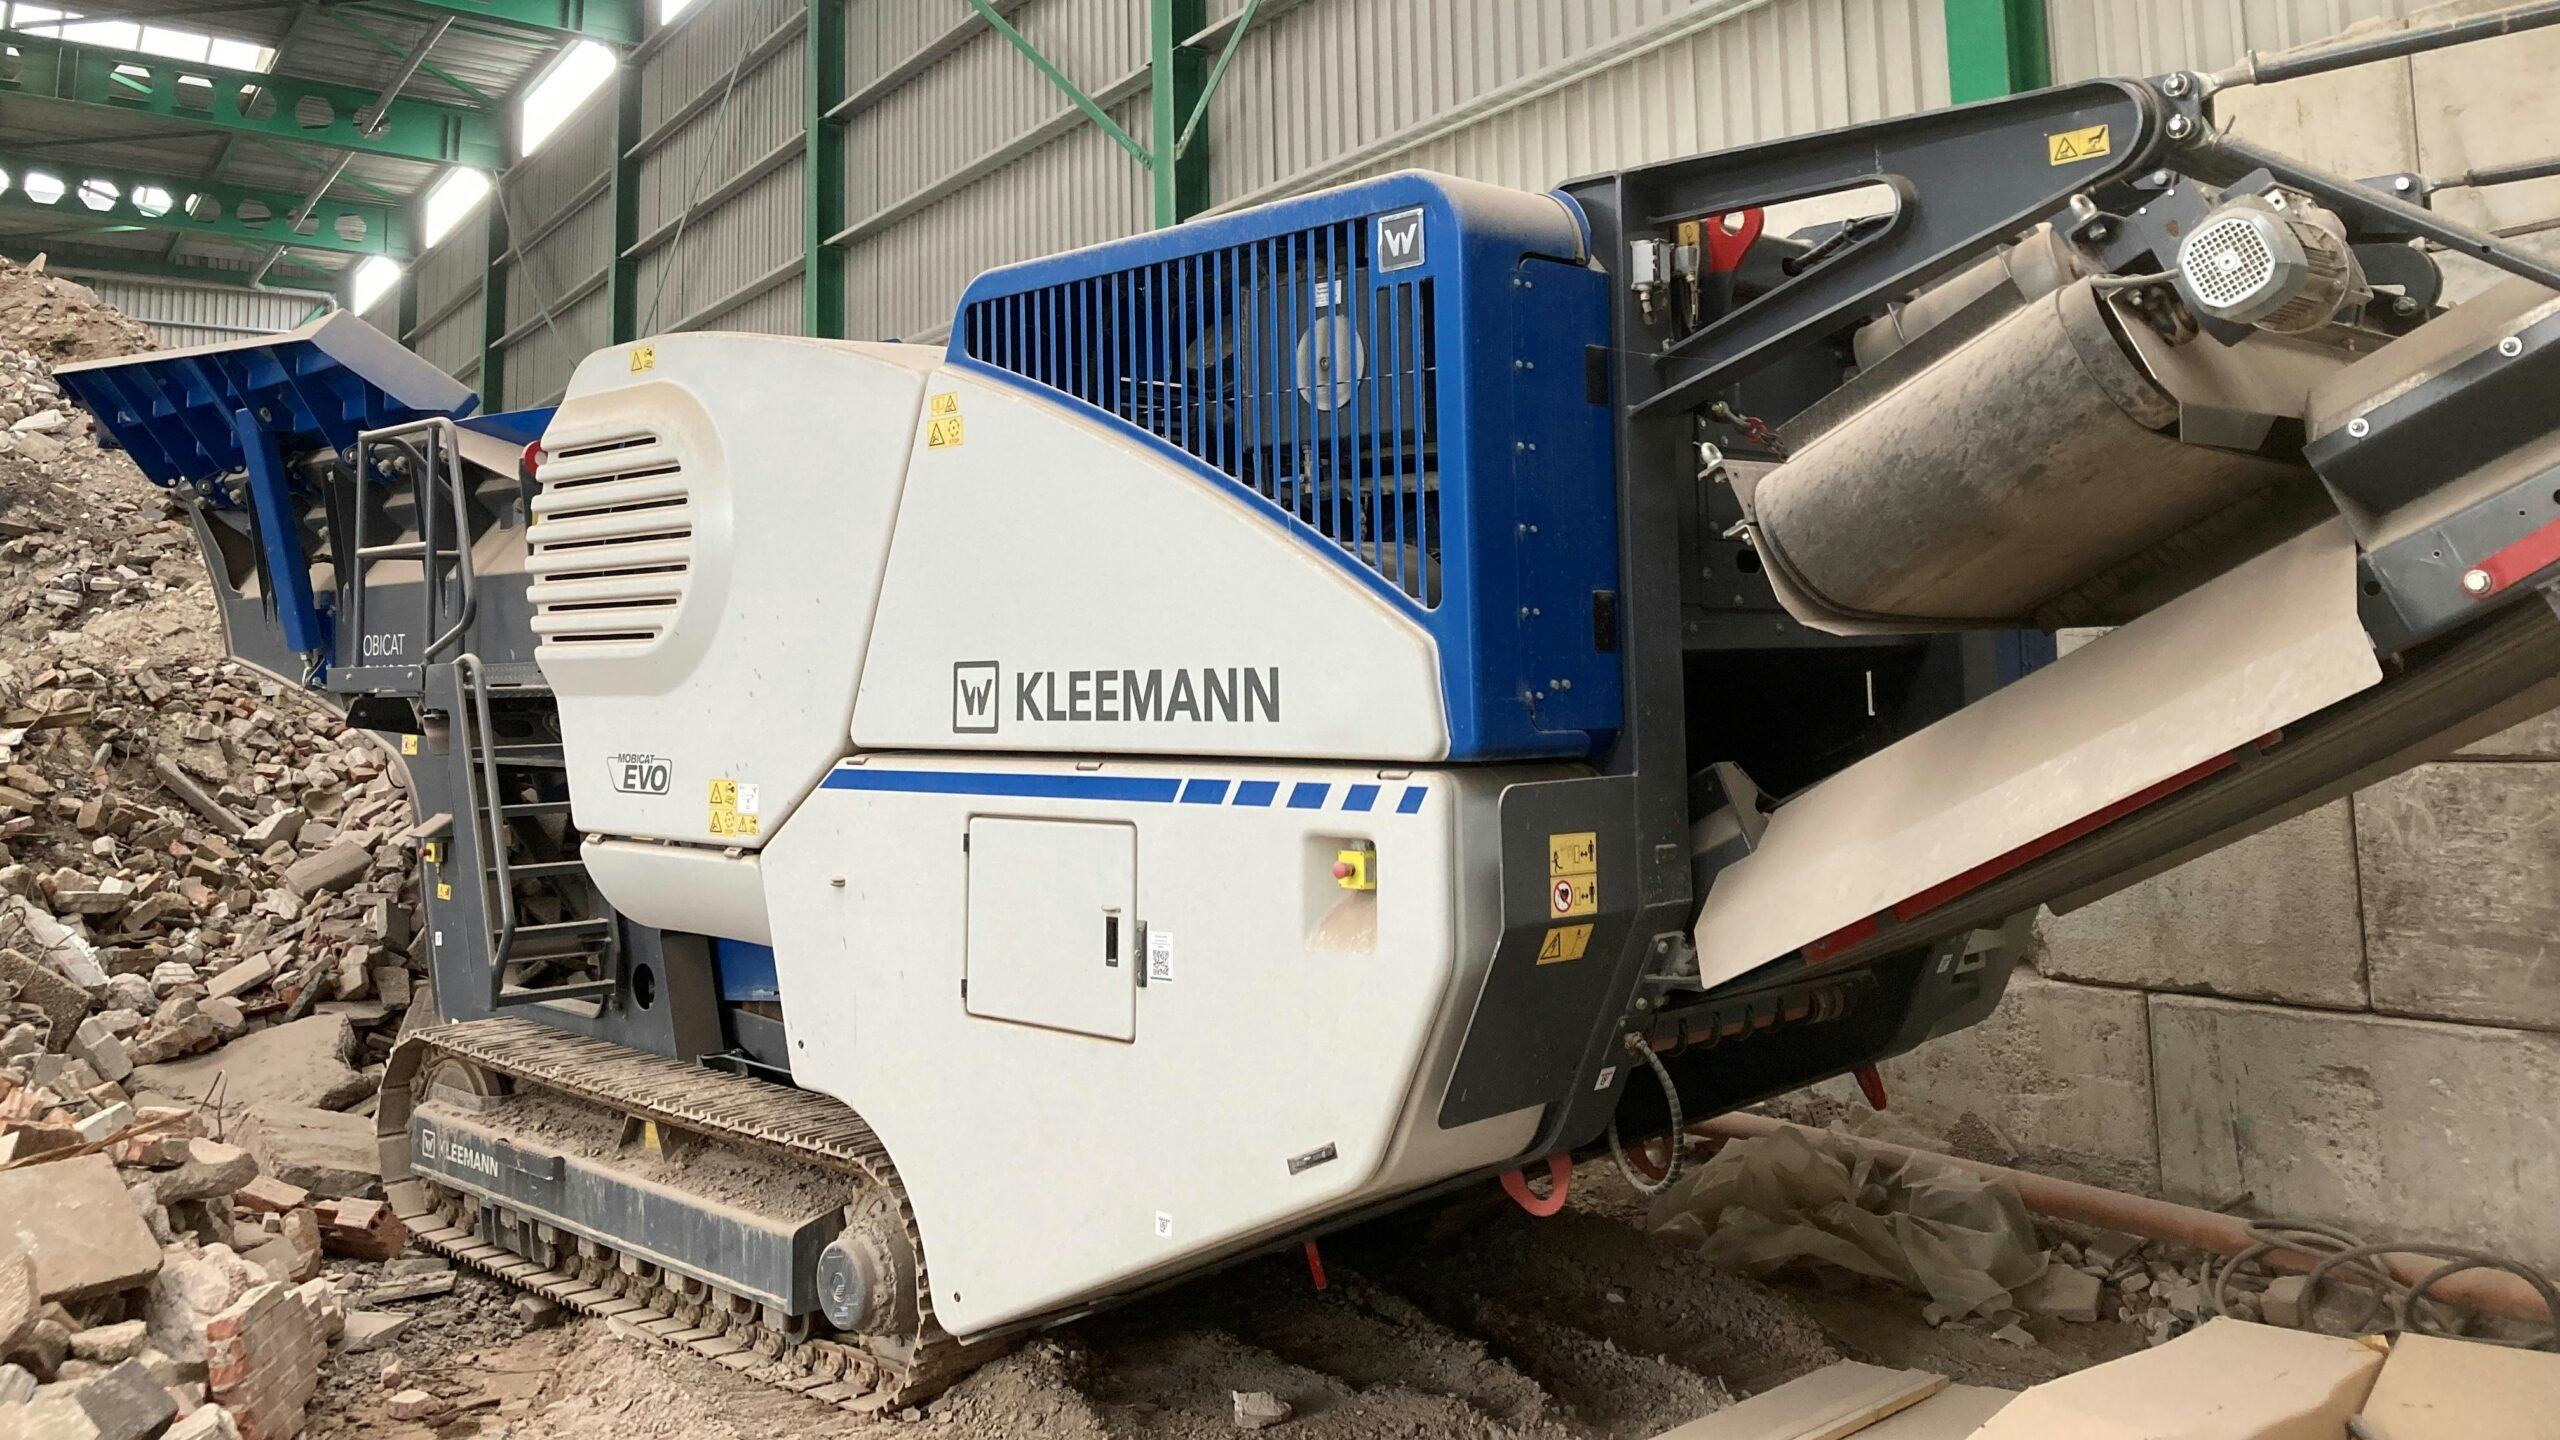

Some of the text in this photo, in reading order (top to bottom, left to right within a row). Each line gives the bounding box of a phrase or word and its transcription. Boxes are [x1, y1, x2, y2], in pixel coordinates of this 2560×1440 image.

[1384, 223, 1418, 258] W
[363, 633, 406, 657] OBICAT
[960, 666, 1280, 723] W KLEEMANN
[617, 753, 656, 764] MOBICAT
[623, 764, 668, 791] EVO
